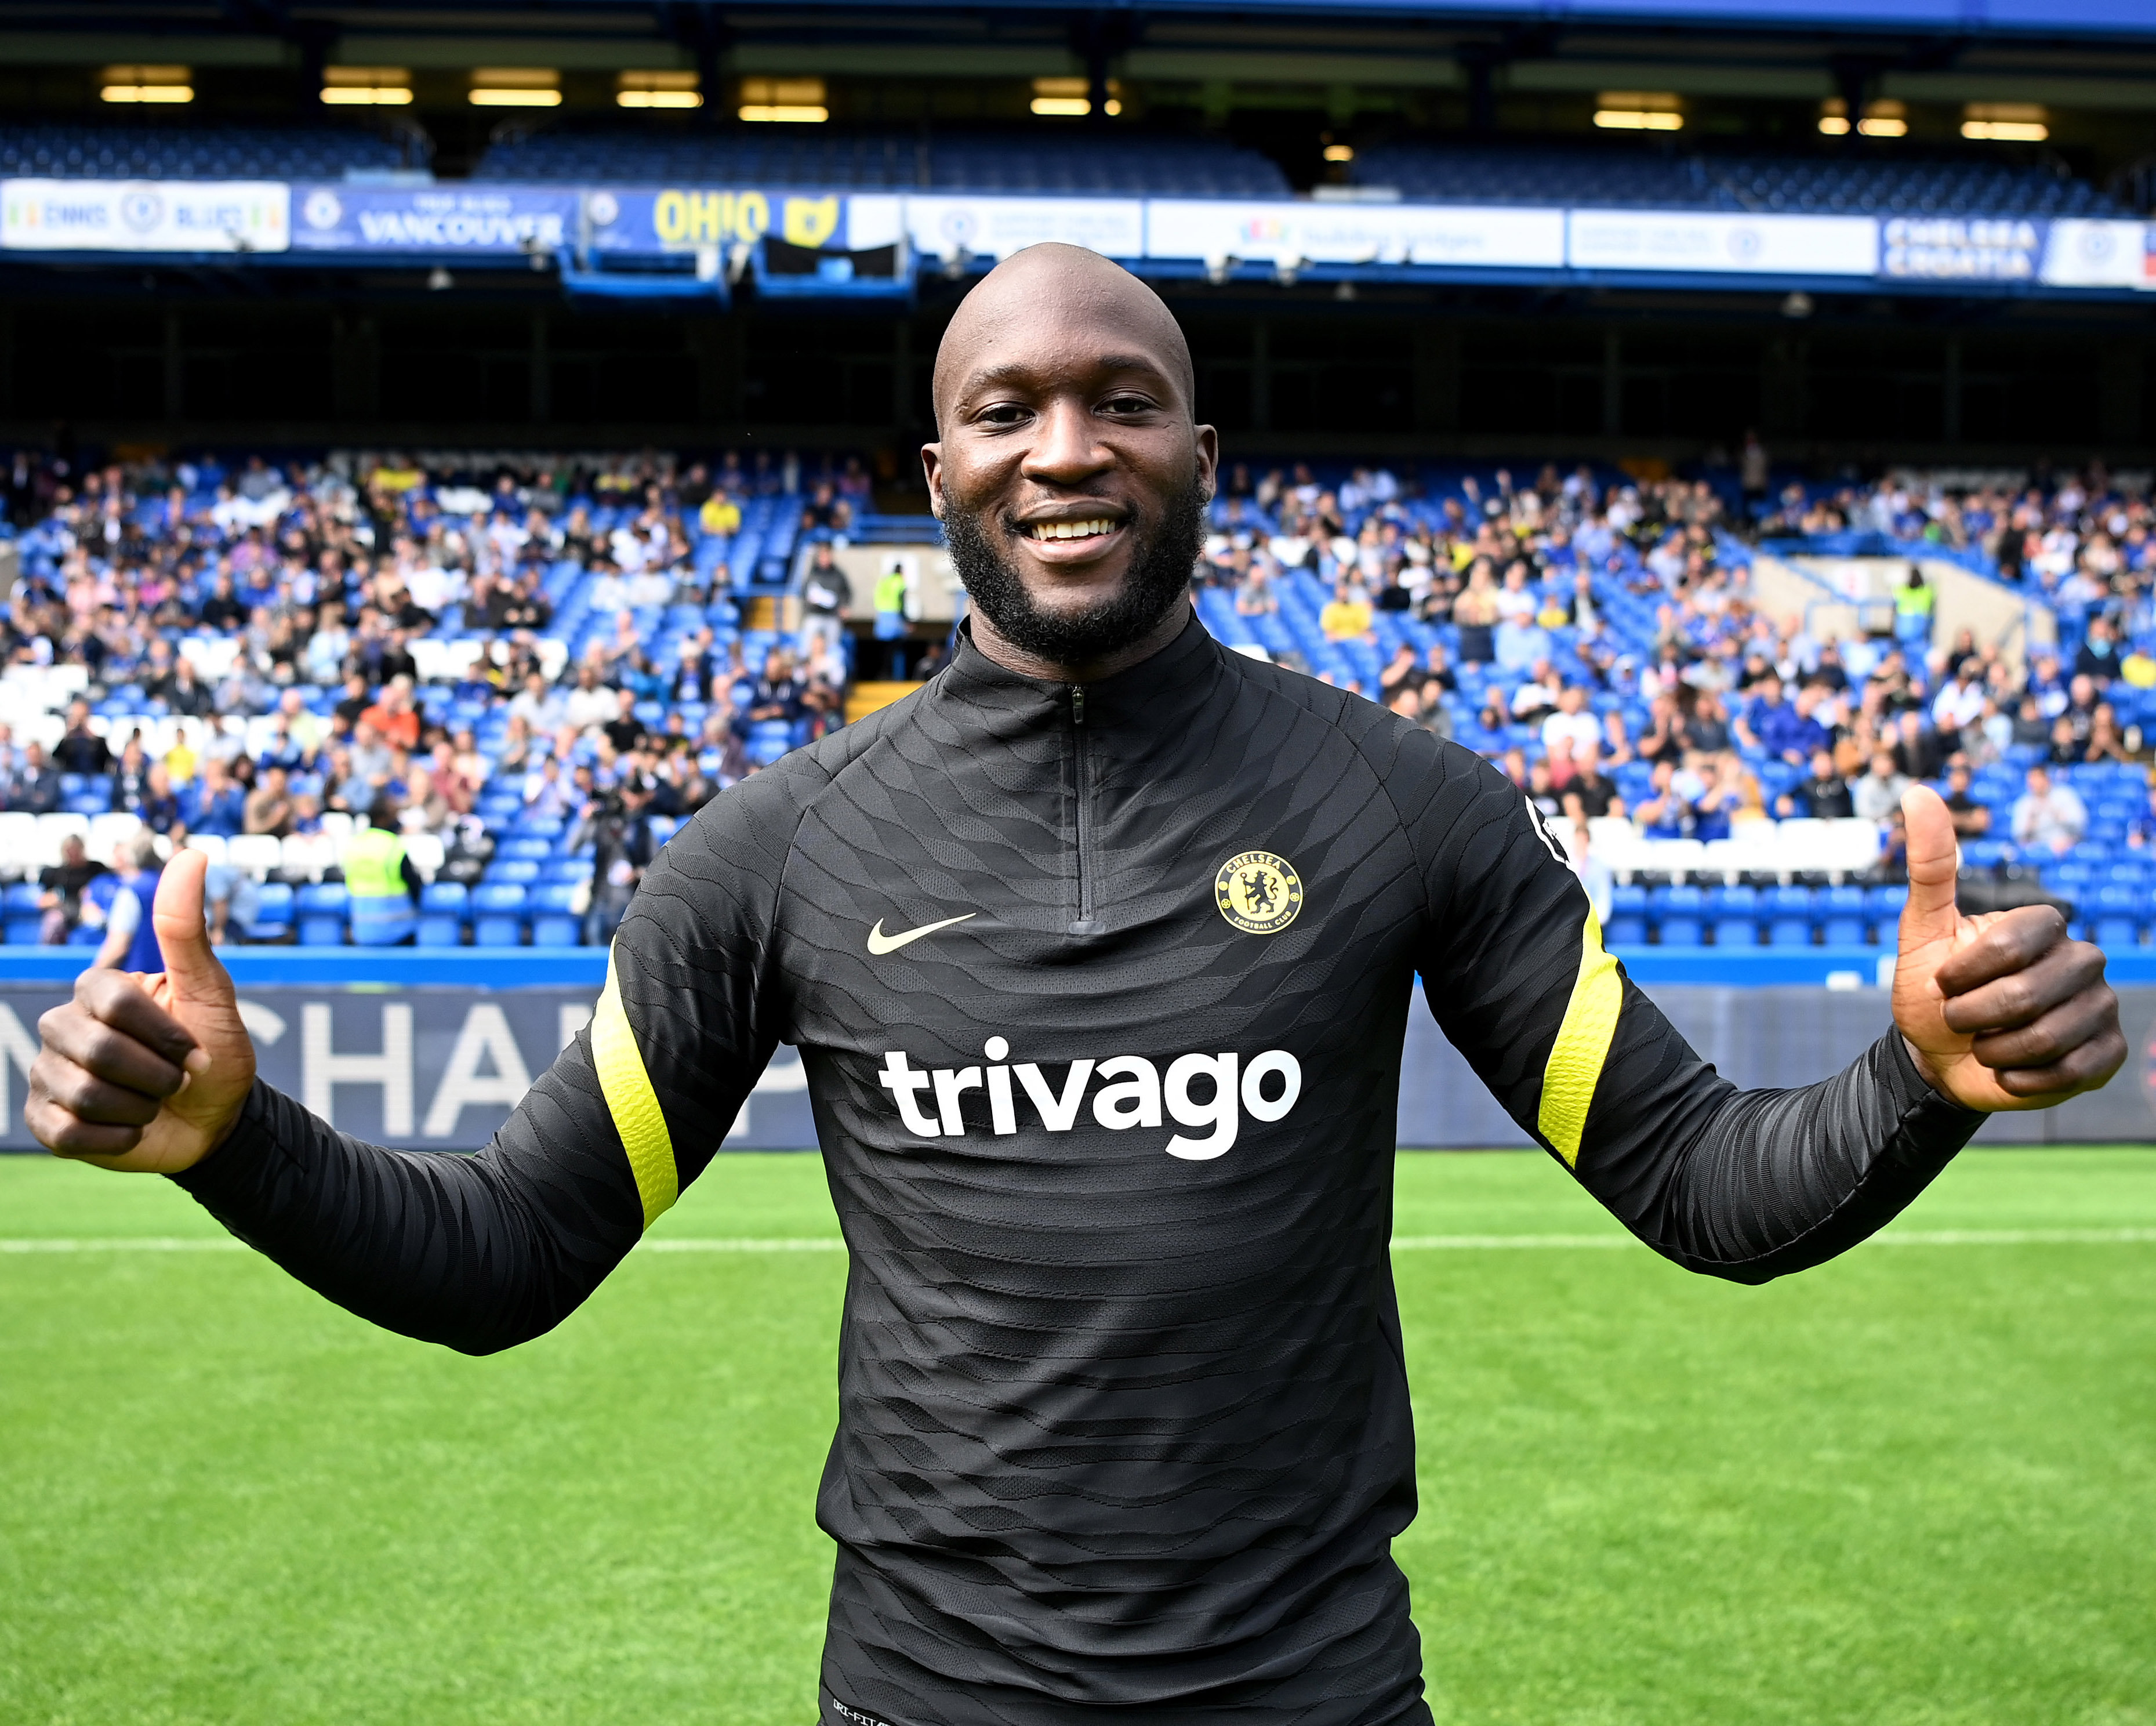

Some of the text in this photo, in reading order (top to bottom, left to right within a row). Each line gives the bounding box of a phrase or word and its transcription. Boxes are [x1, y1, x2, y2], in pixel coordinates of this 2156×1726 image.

[358, 211, 563, 248] VANCOUVER
[654, 189, 770, 243] OHIO
[1226, 854, 1281, 873] CHELSEA
[1234, 911, 1291, 929] FOOTBALL CLUB
[879, 1036, 1301, 1160] trivago
[833, 1698, 876, 1726] DRI-FIT
